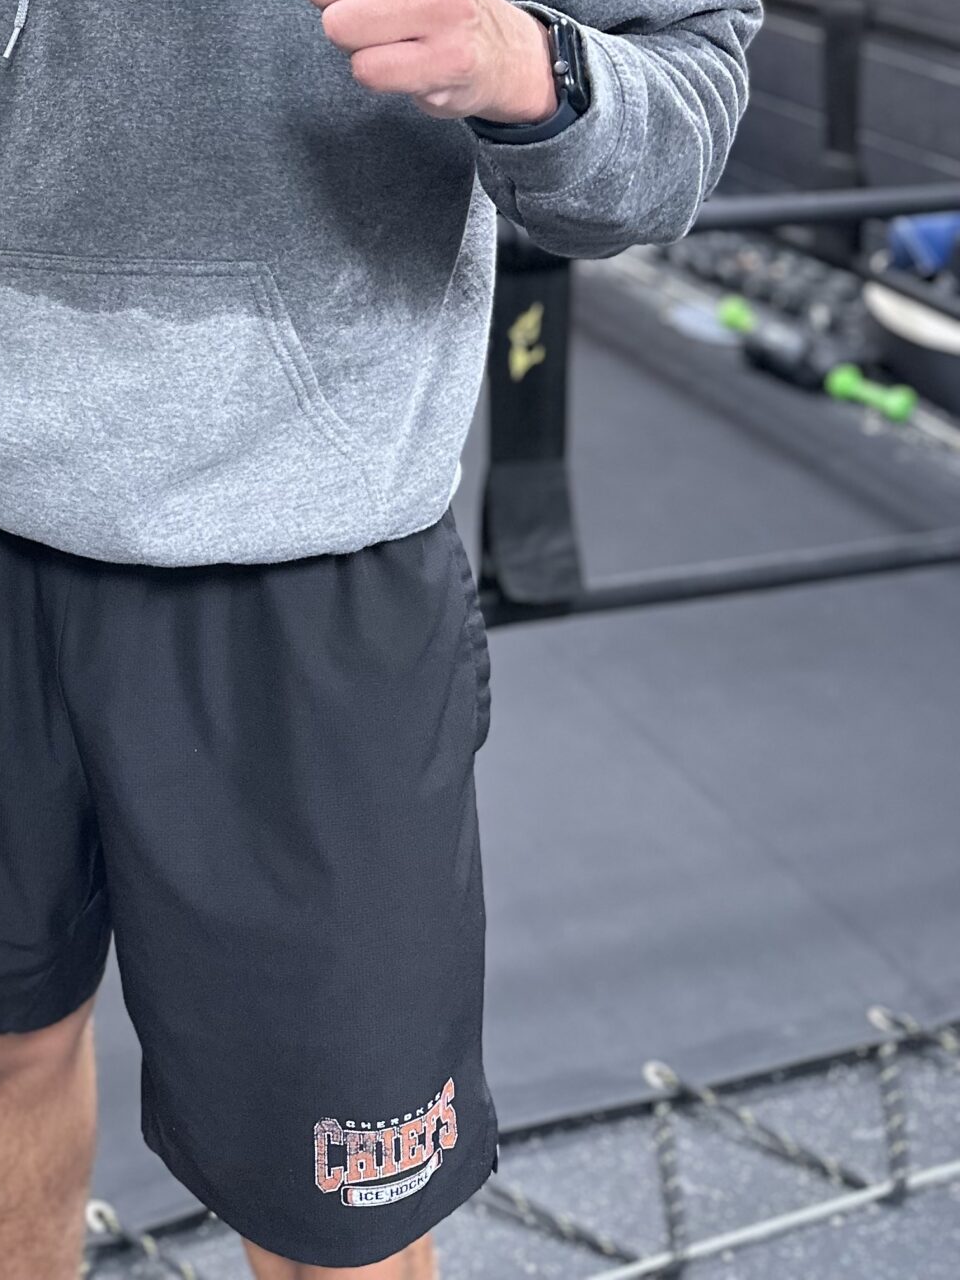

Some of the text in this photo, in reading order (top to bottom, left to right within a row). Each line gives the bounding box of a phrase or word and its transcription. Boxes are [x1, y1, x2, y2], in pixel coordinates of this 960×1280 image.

[314, 1076, 458, 1193] CHIEFS
[359, 1168, 431, 1201] ICE HOCK
